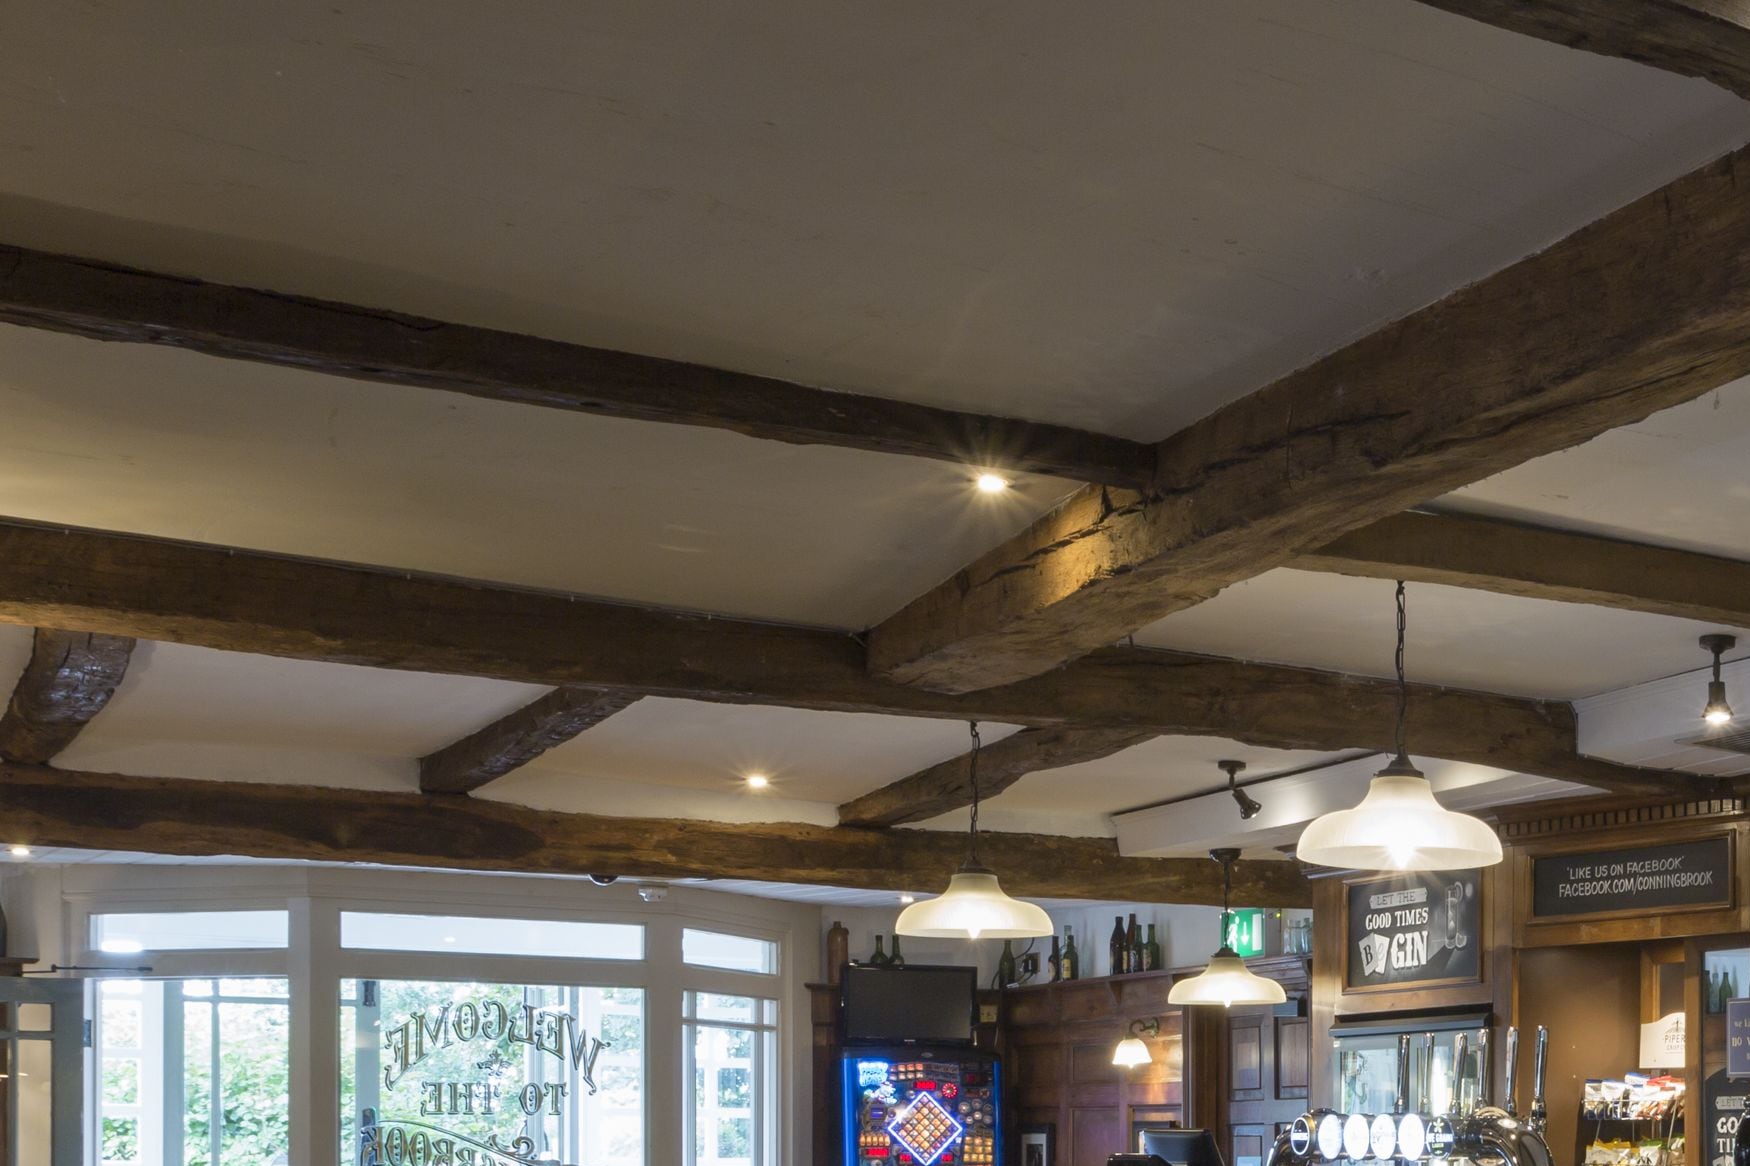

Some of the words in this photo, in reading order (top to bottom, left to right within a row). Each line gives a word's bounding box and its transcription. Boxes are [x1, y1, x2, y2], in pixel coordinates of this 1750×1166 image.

[1594, 864, 1608, 878] US
[1610, 863, 1624, 877] ON
[1376, 894, 1395, 906] LET
[1398, 890, 1416, 903] THE
[1365, 912, 1392, 931] GOOD
[1394, 907, 1430, 928] TIMES
[1731, 1036, 1743, 1047] no
[1716, 1116, 1739, 1134] GO
